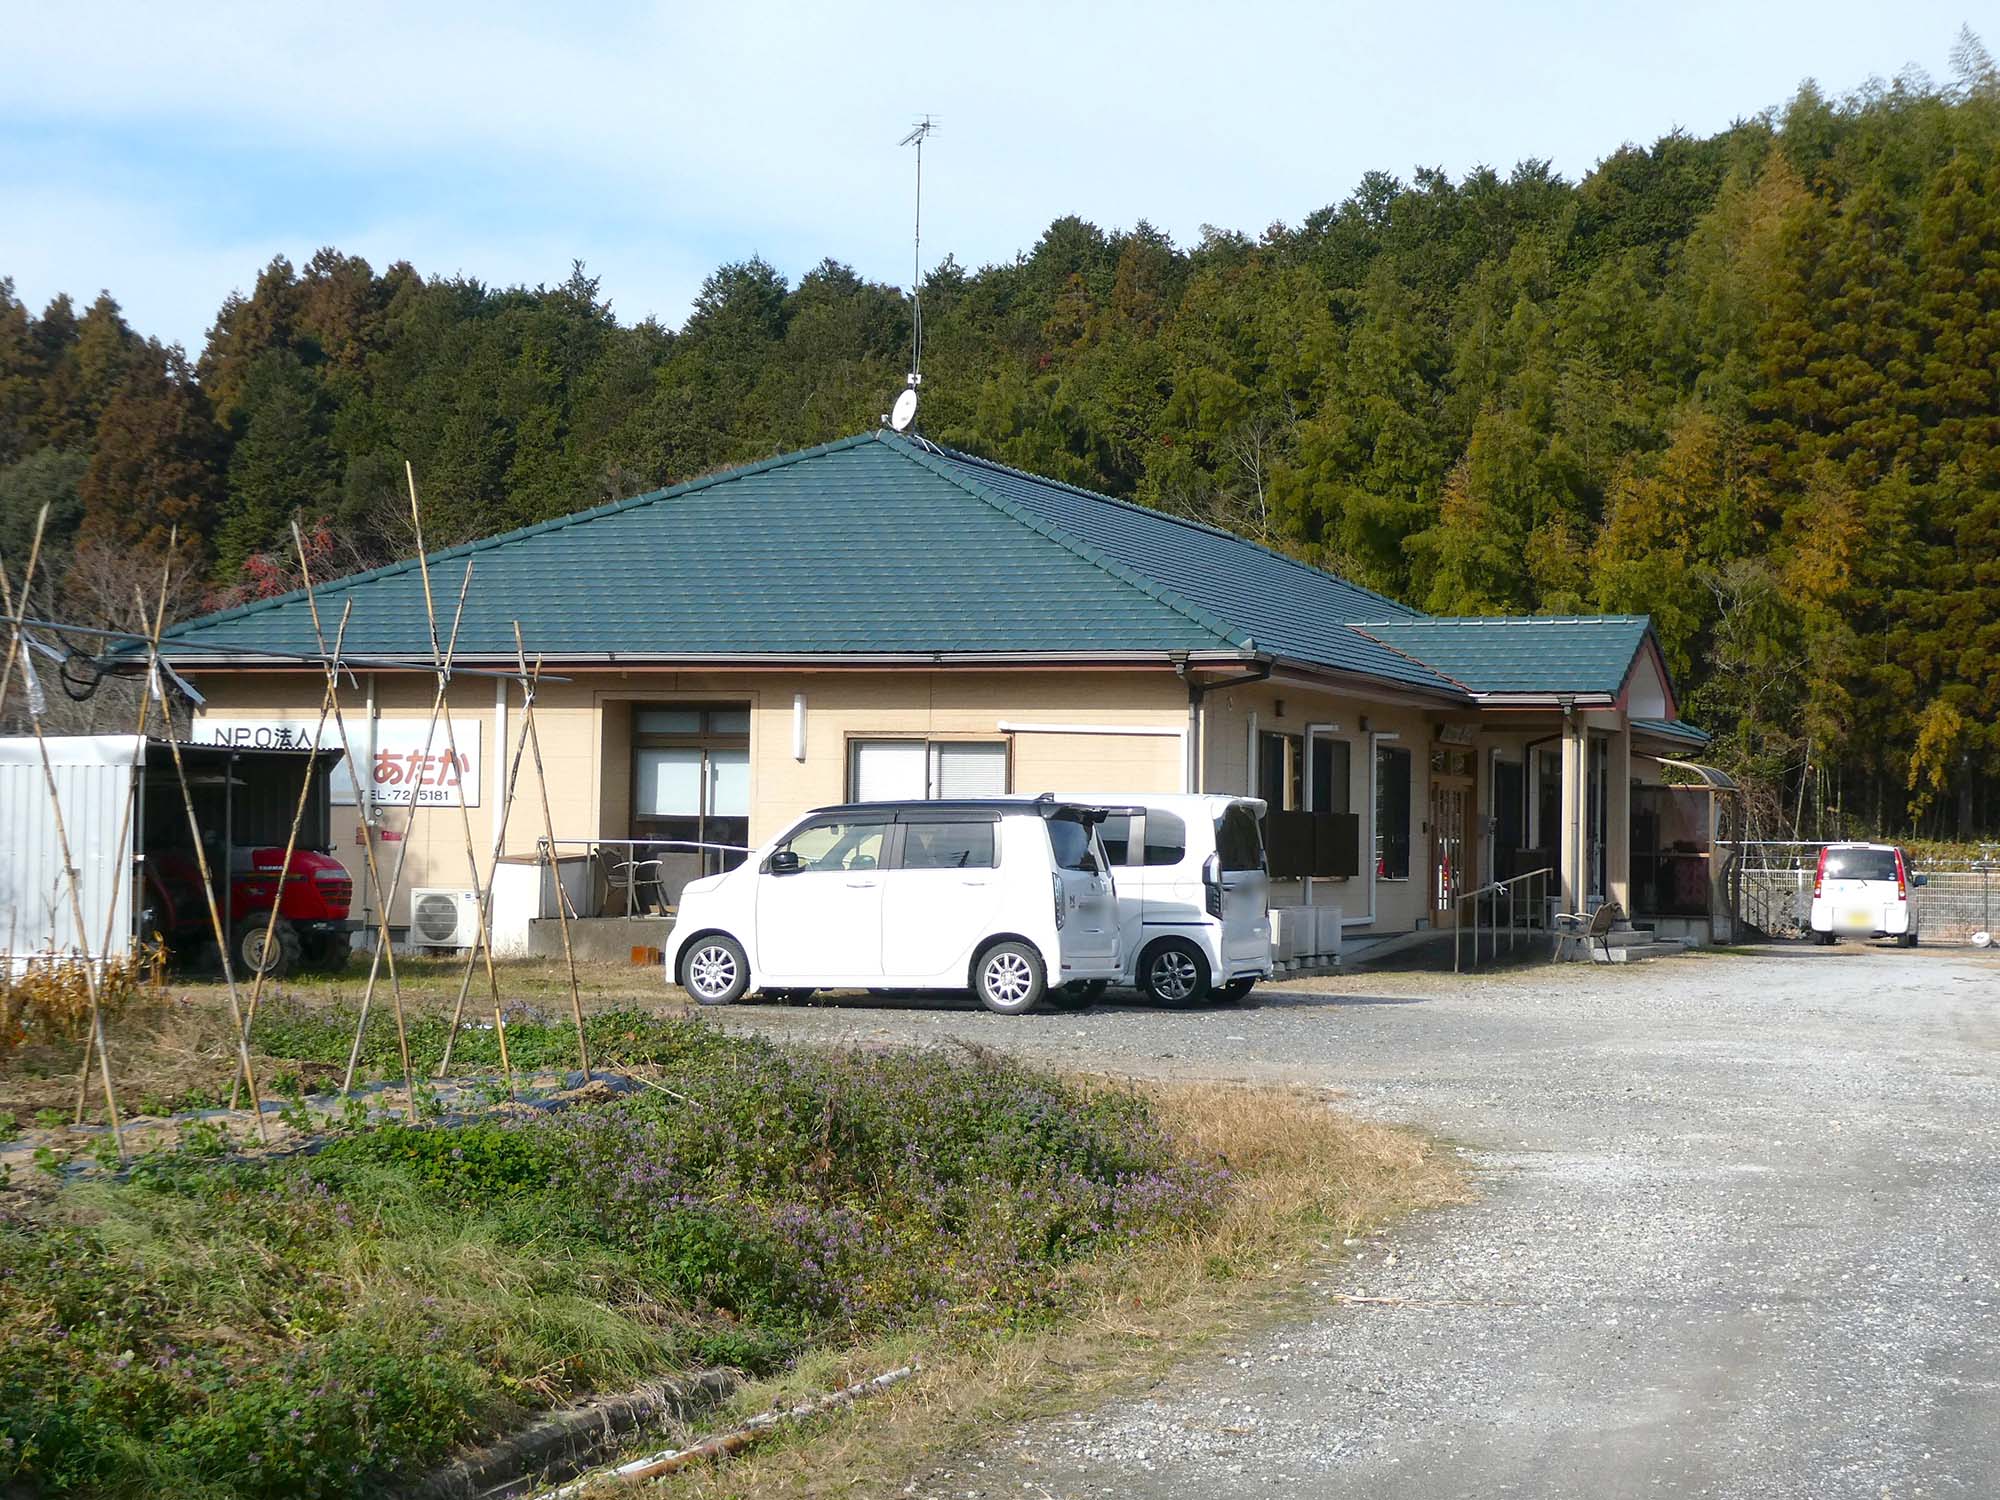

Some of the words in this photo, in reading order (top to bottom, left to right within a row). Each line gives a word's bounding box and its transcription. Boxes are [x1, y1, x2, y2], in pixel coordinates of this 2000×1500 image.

[215, 727, 312, 747] NPO法人
[373, 748, 470, 786] あたか
